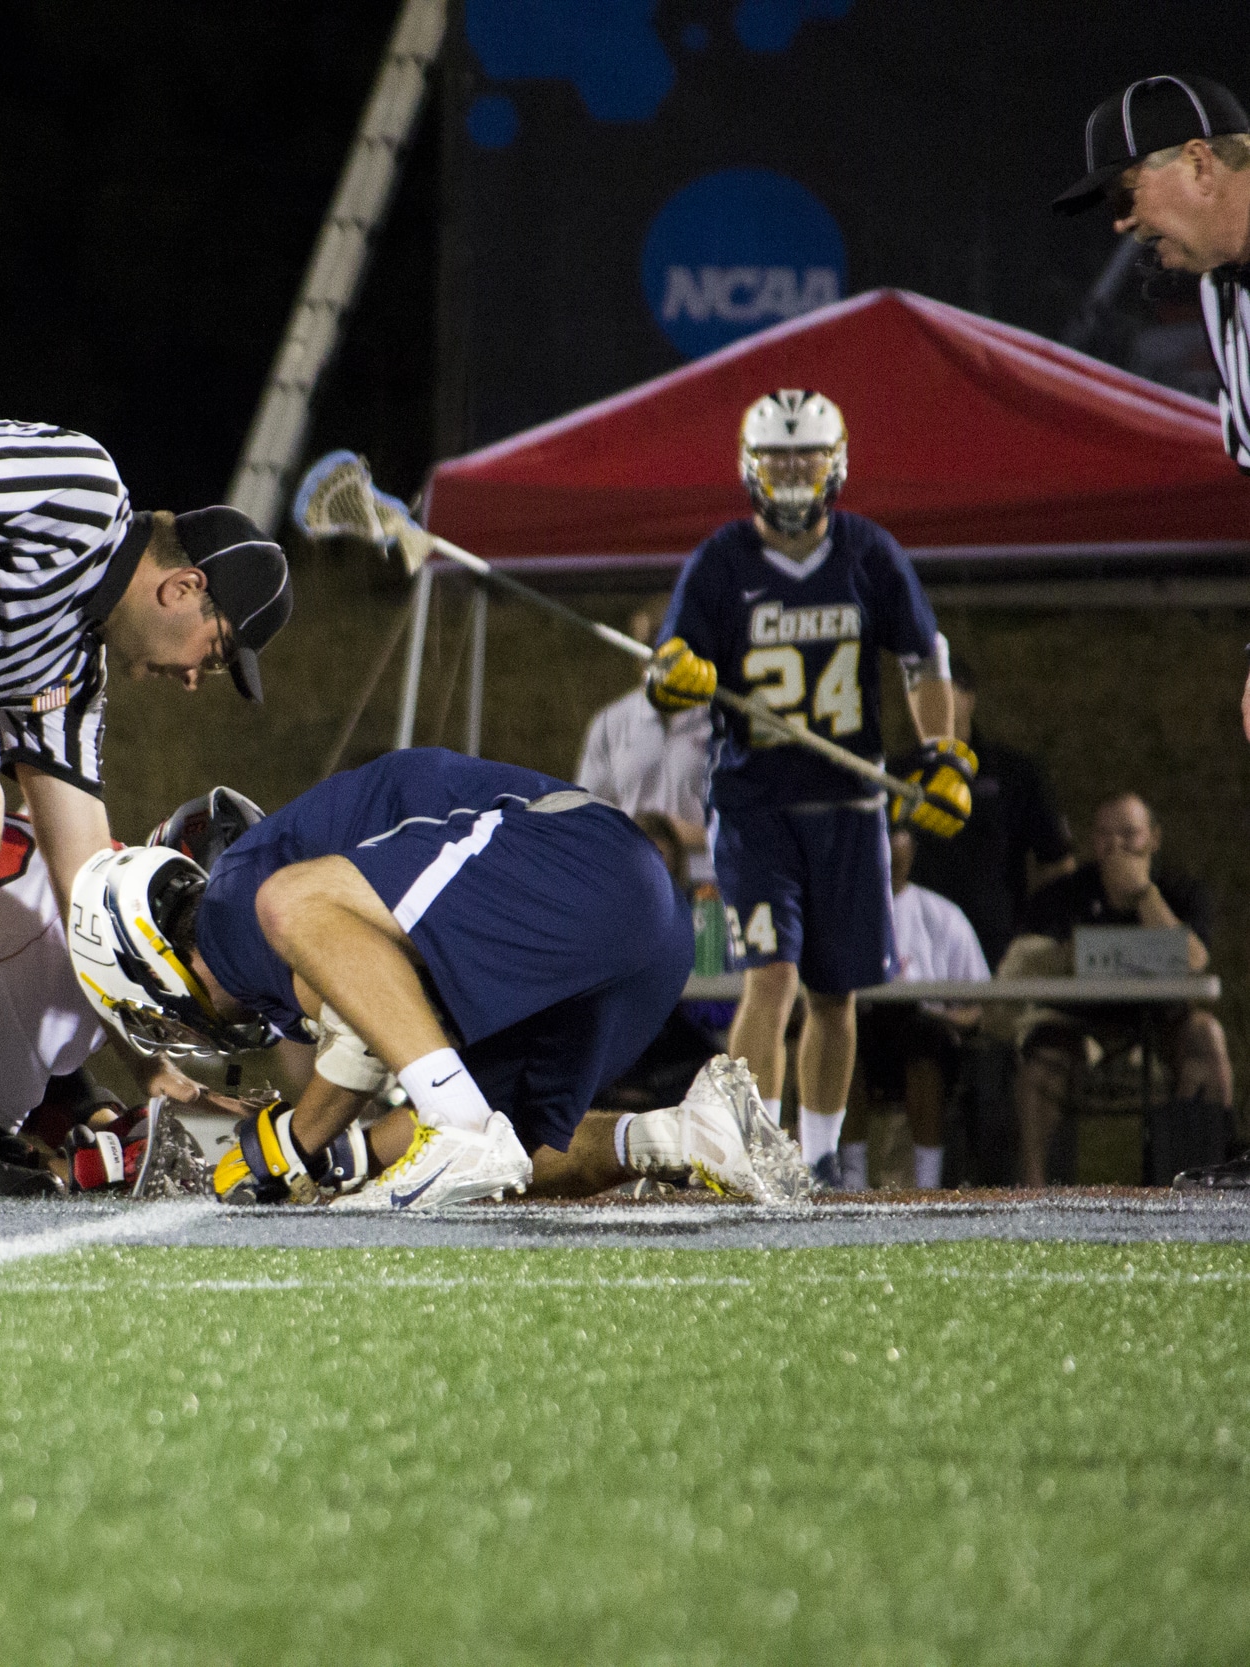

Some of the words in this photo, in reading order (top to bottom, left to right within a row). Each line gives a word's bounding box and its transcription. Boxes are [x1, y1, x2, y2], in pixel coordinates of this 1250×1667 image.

[663, 266, 841, 320] NCAA
[750, 601, 862, 645] COKER
[742, 640, 863, 747] 24
